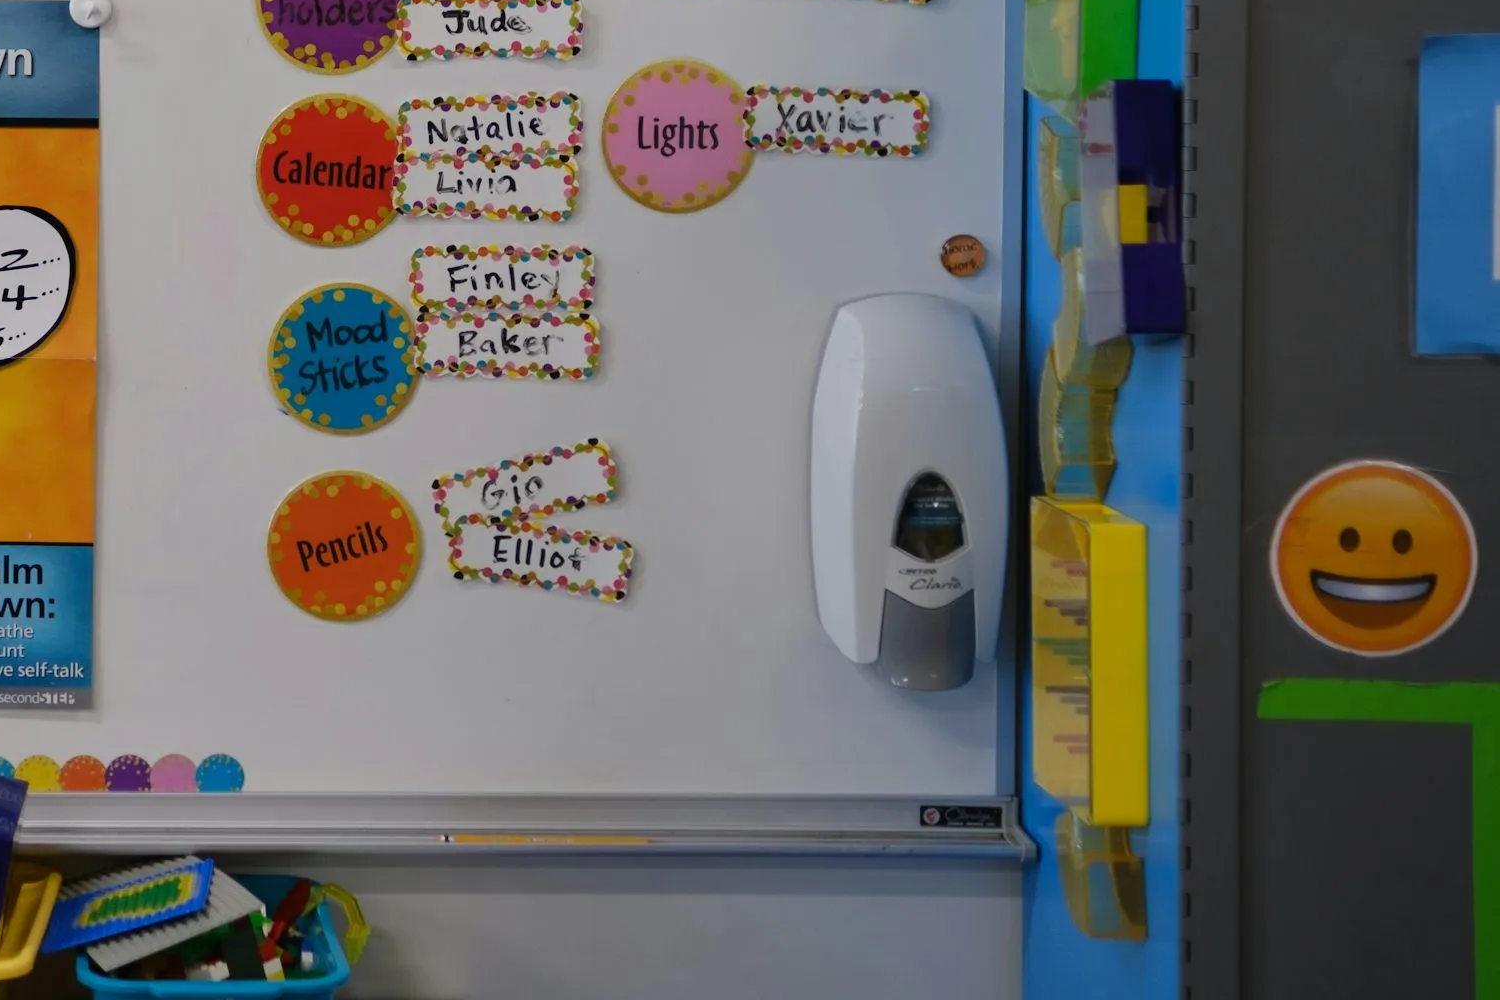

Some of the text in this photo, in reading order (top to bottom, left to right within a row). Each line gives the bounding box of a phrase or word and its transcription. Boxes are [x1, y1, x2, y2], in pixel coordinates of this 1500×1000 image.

[442, 9, 533, 35] Jude
[427, 111, 549, 146] Natalie
[637, 115, 720, 158] Lights
[272, 150, 393, 190] Calendar
[447, 263, 560, 297] Finley
[305, 310, 388, 352] Mood
[458, 327, 564, 358] Baker
[299, 355, 389, 395] Sticks
[295, 520, 390, 572] Pencils
[18, 660, 85, 679] self-talk
